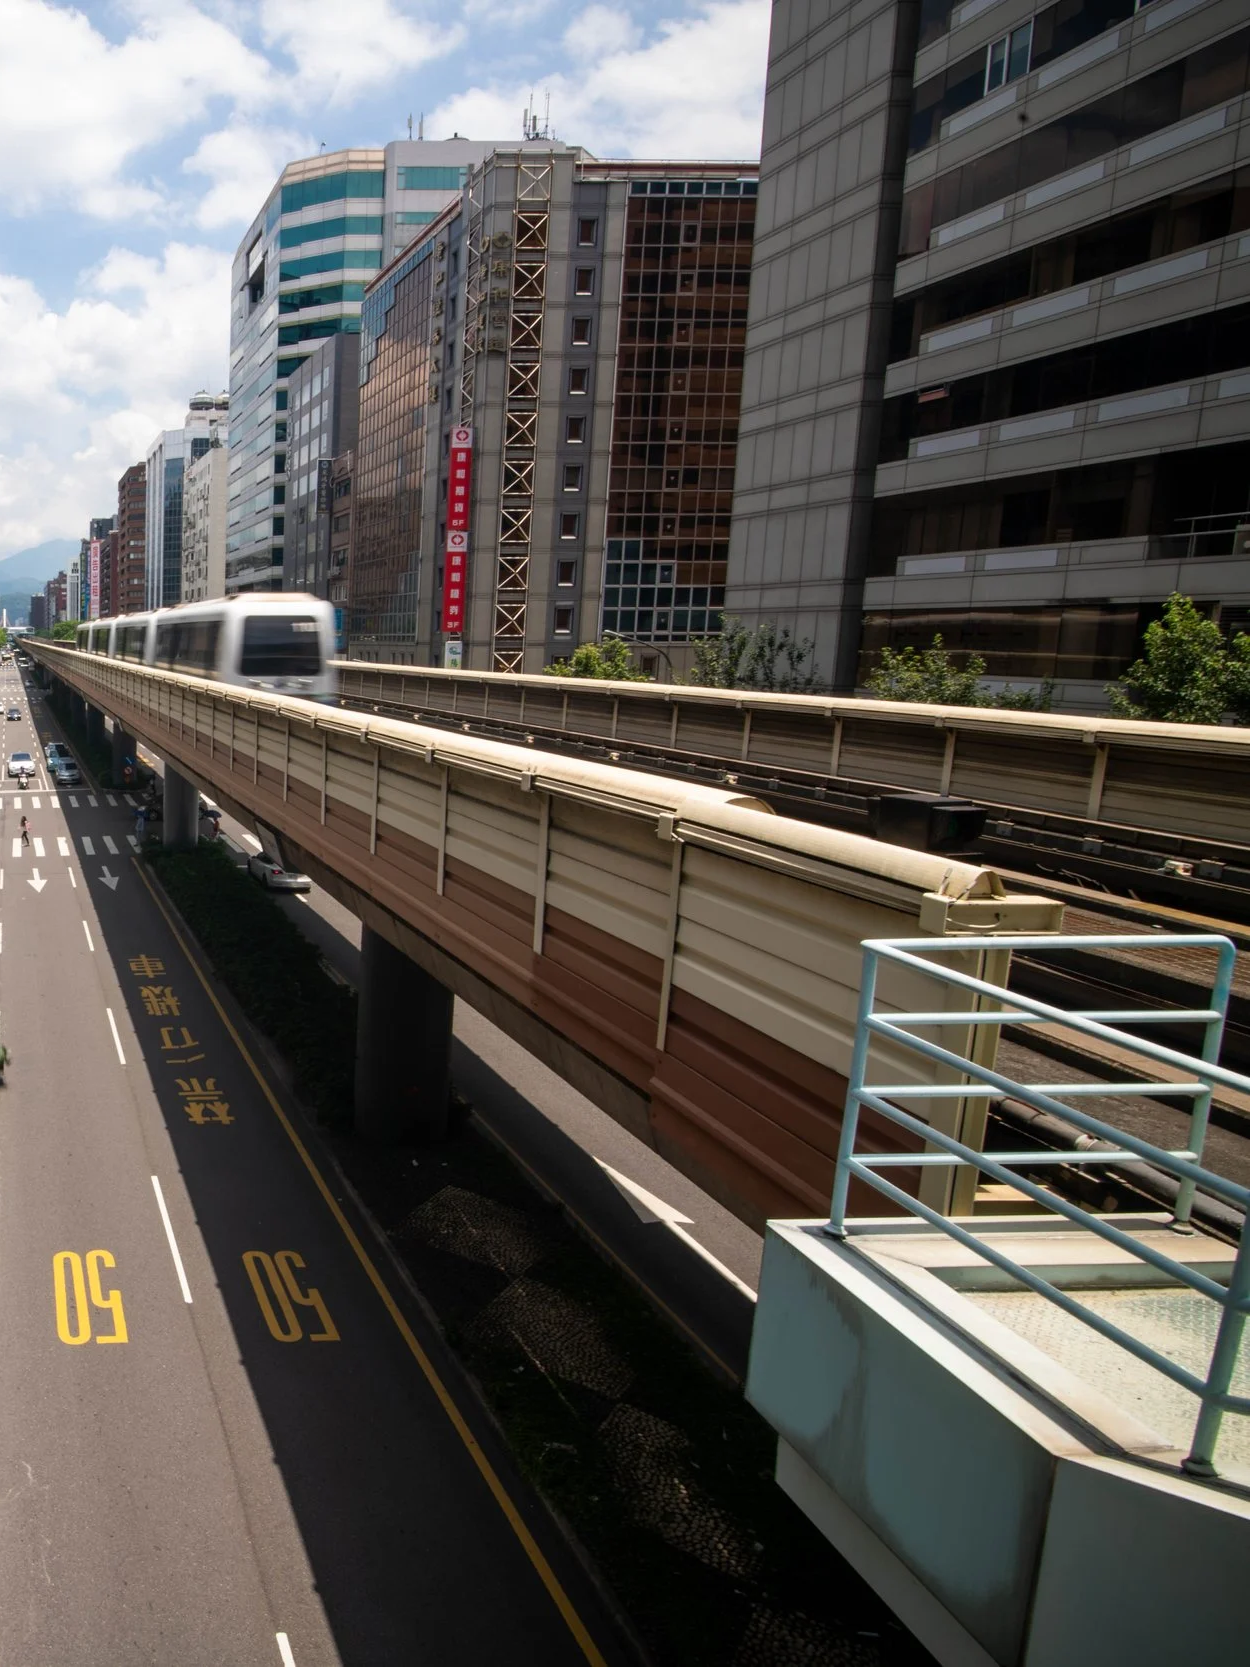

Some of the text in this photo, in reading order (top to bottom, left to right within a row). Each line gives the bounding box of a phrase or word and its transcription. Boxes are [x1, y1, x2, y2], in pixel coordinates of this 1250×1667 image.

[128, 954, 236, 1125] 禁行機車
[53, 1249, 129, 1345] 50
[241, 1250, 341, 1342] 50
